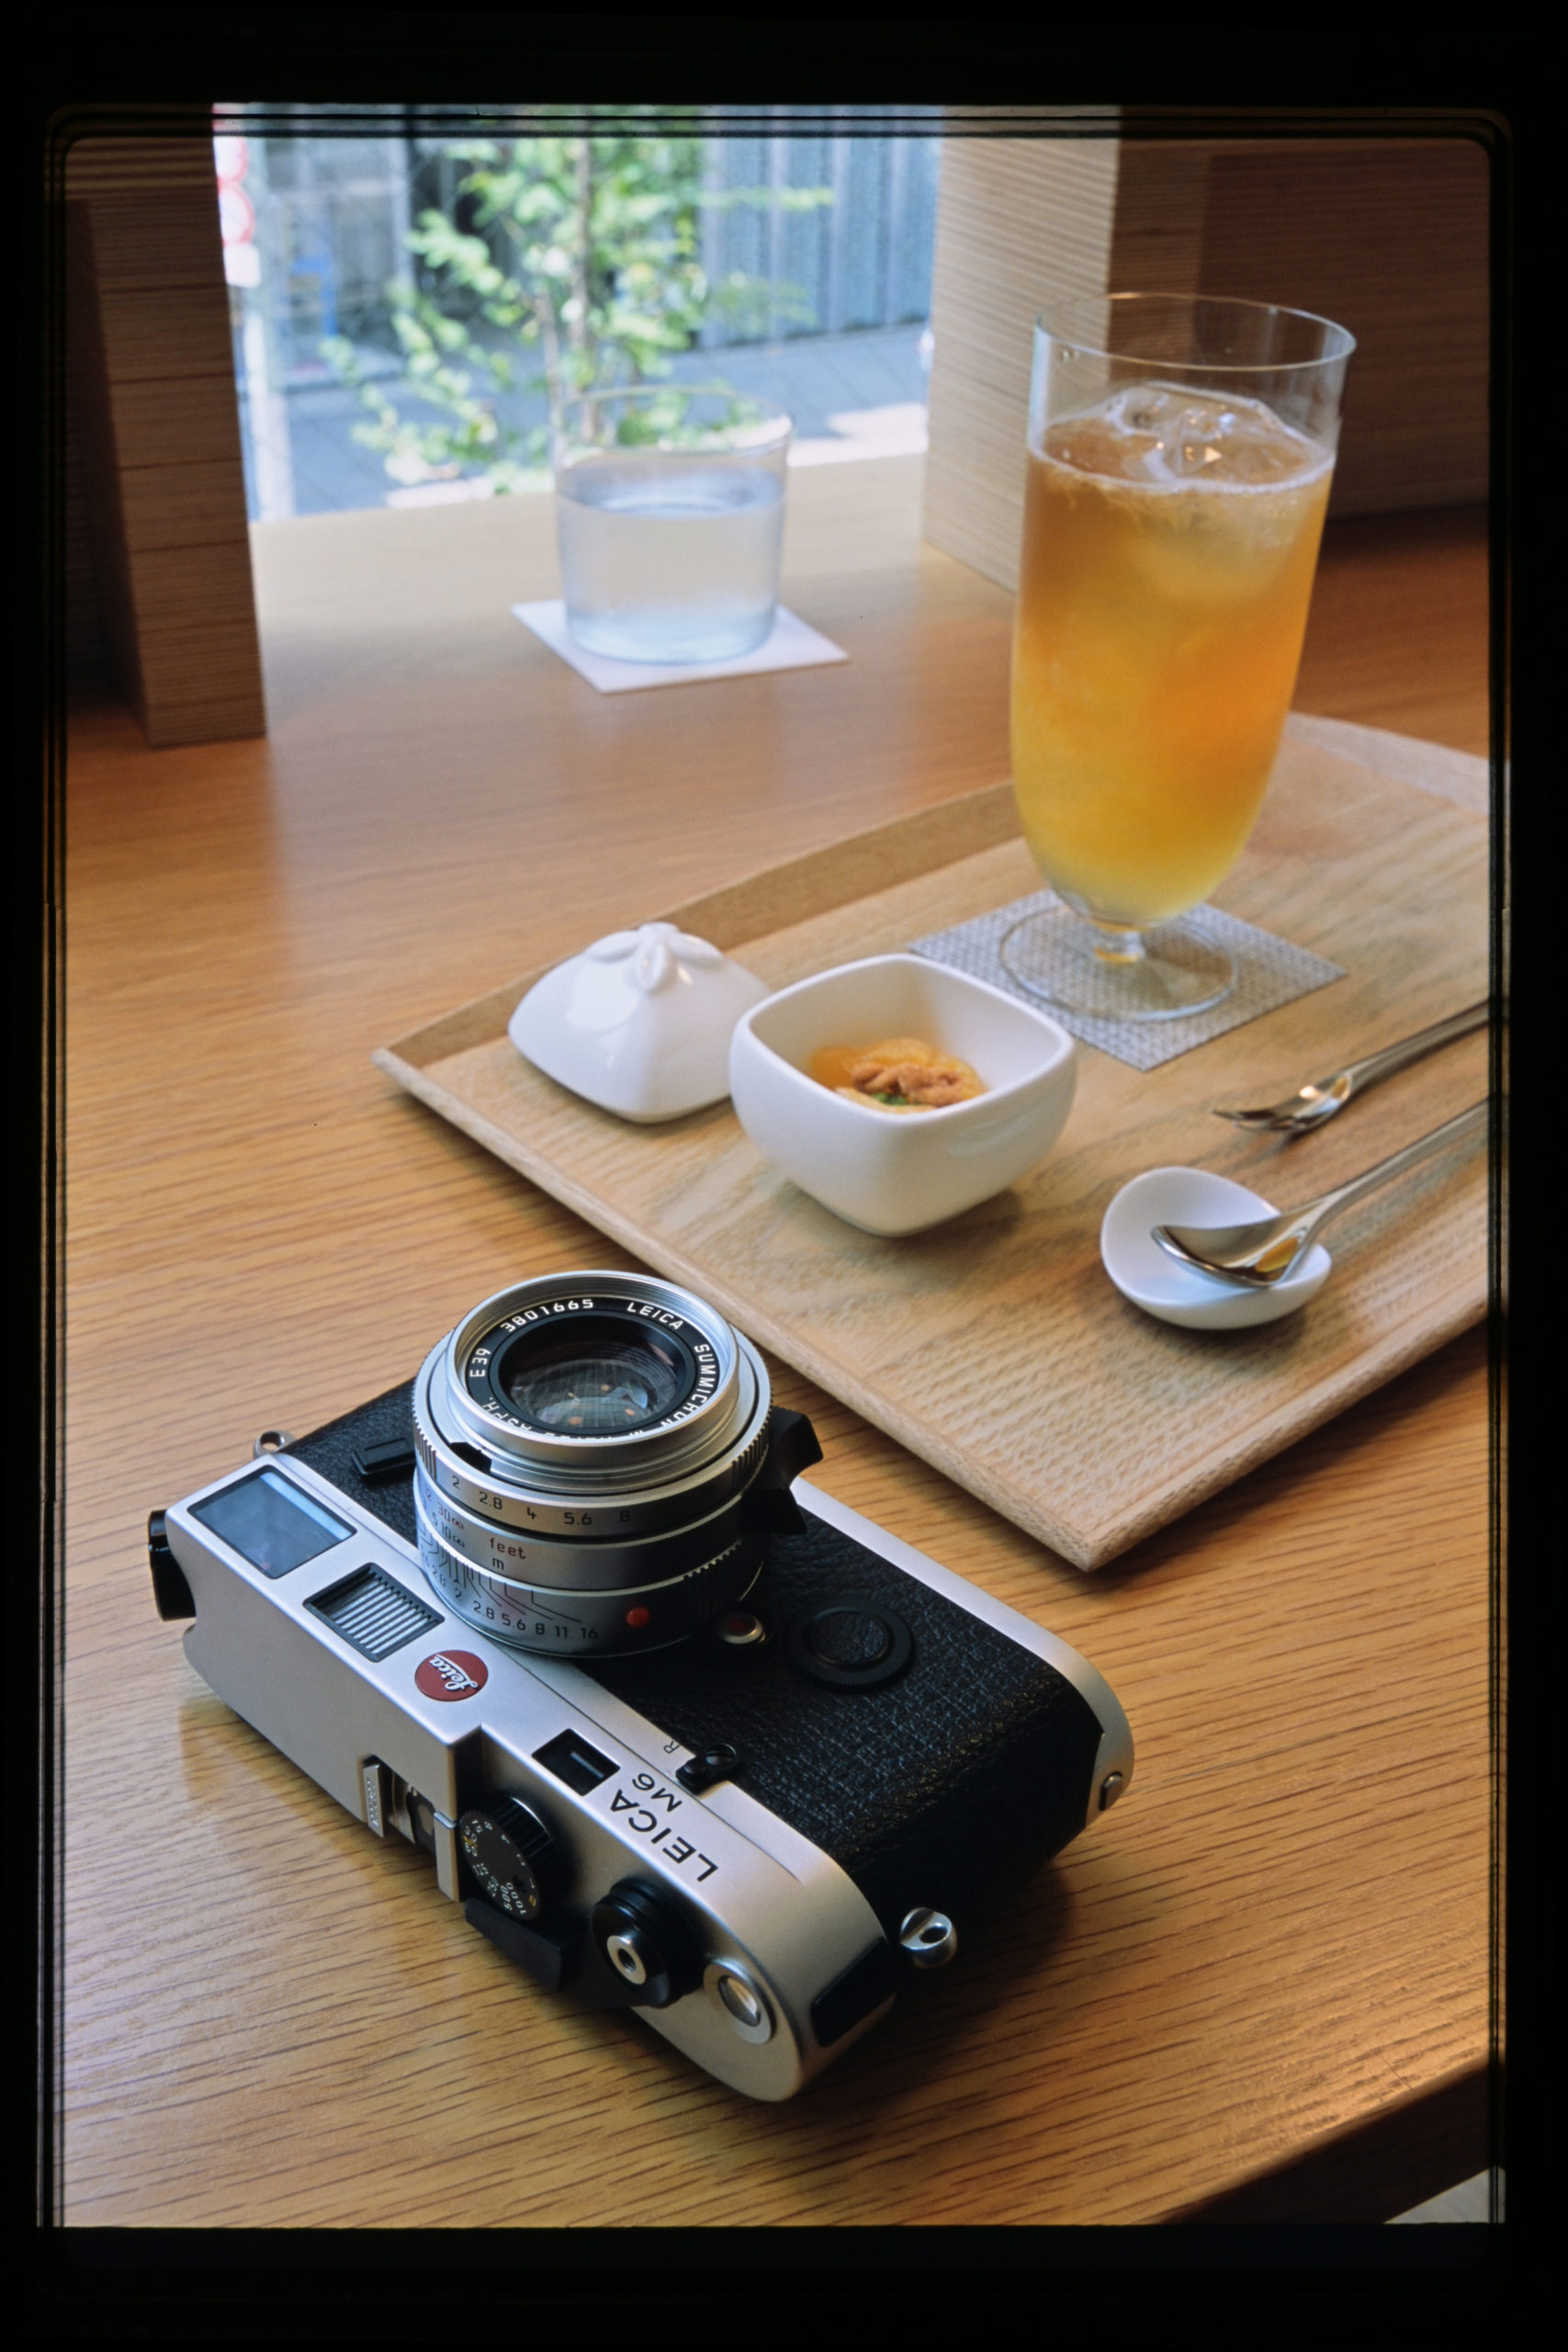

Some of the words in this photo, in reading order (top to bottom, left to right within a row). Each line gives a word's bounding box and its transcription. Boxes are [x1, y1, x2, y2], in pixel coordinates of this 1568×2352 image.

[500, 1298, 594, 1333] 3801665
[627, 1302, 684, 1330] LEICA
[452, 1475, 460, 1490] 2
[479, 1490, 503, 1510] 2.8
[526, 1507, 537, 1521] 4
[564, 1512, 592, 1525] 5.6
[619, 1510, 630, 1523] 8
[490, 1537, 526, 1560] feet
[492, 1557, 504, 1570] m
[473, 1600, 495, 1621] 2.8
[502, 1614, 527, 1631] 5.6
[536, 1623, 546, 1634] 8
[555, 1625, 569, 1638] 11
[581, 1627, 599, 1640] 16
[429, 1654, 478, 1690] Leica
[632, 1773, 682, 1813] M6
[610, 1789, 718, 1882] LEICA
[505, 1882, 527, 1915] 1000
